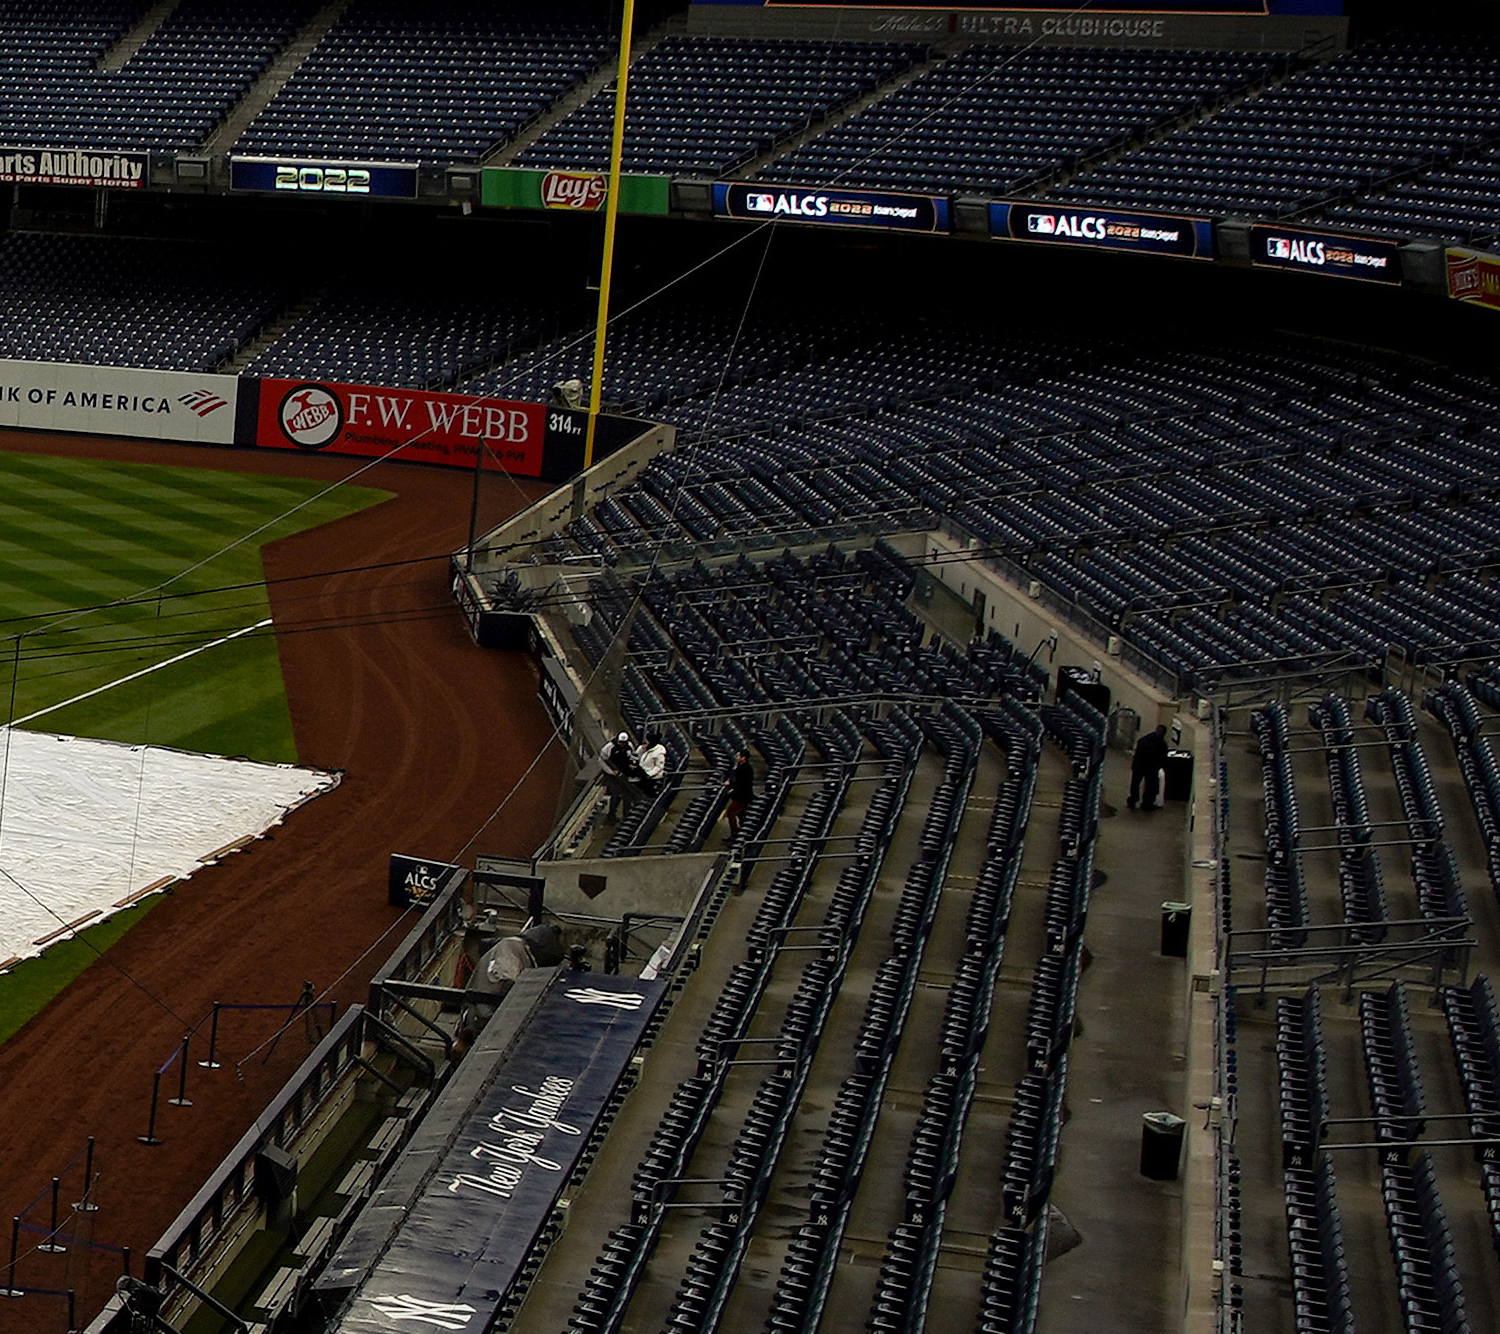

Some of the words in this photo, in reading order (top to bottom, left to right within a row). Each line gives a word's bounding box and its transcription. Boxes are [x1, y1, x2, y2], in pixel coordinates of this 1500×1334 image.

[1040, 17, 1164, 38] CLUBHOUSE
[39, 152, 143, 180] Authority
[16, 175, 50, 183] Parts
[52, 176, 92, 186] Super
[95, 179, 138, 187] Stores
[276, 167, 371, 193] 2022
[546, 175, 603, 207] Lay's
[774, 193, 829, 217] ALCS
[1054, 214, 1107, 240] ALCS
[1289, 240, 1325, 265] ALCS
[28, 388, 57, 404] OF
[63, 392, 171, 413] AMERICA
[292, 405, 330, 430] WEBB
[345, 392, 413, 430] F.W.
[424, 400, 529, 443] WEBB
[549, 412, 572, 434] 314
[448, 1160, 523, 1199] New
[489, 1074, 583, 1136] Yankees
